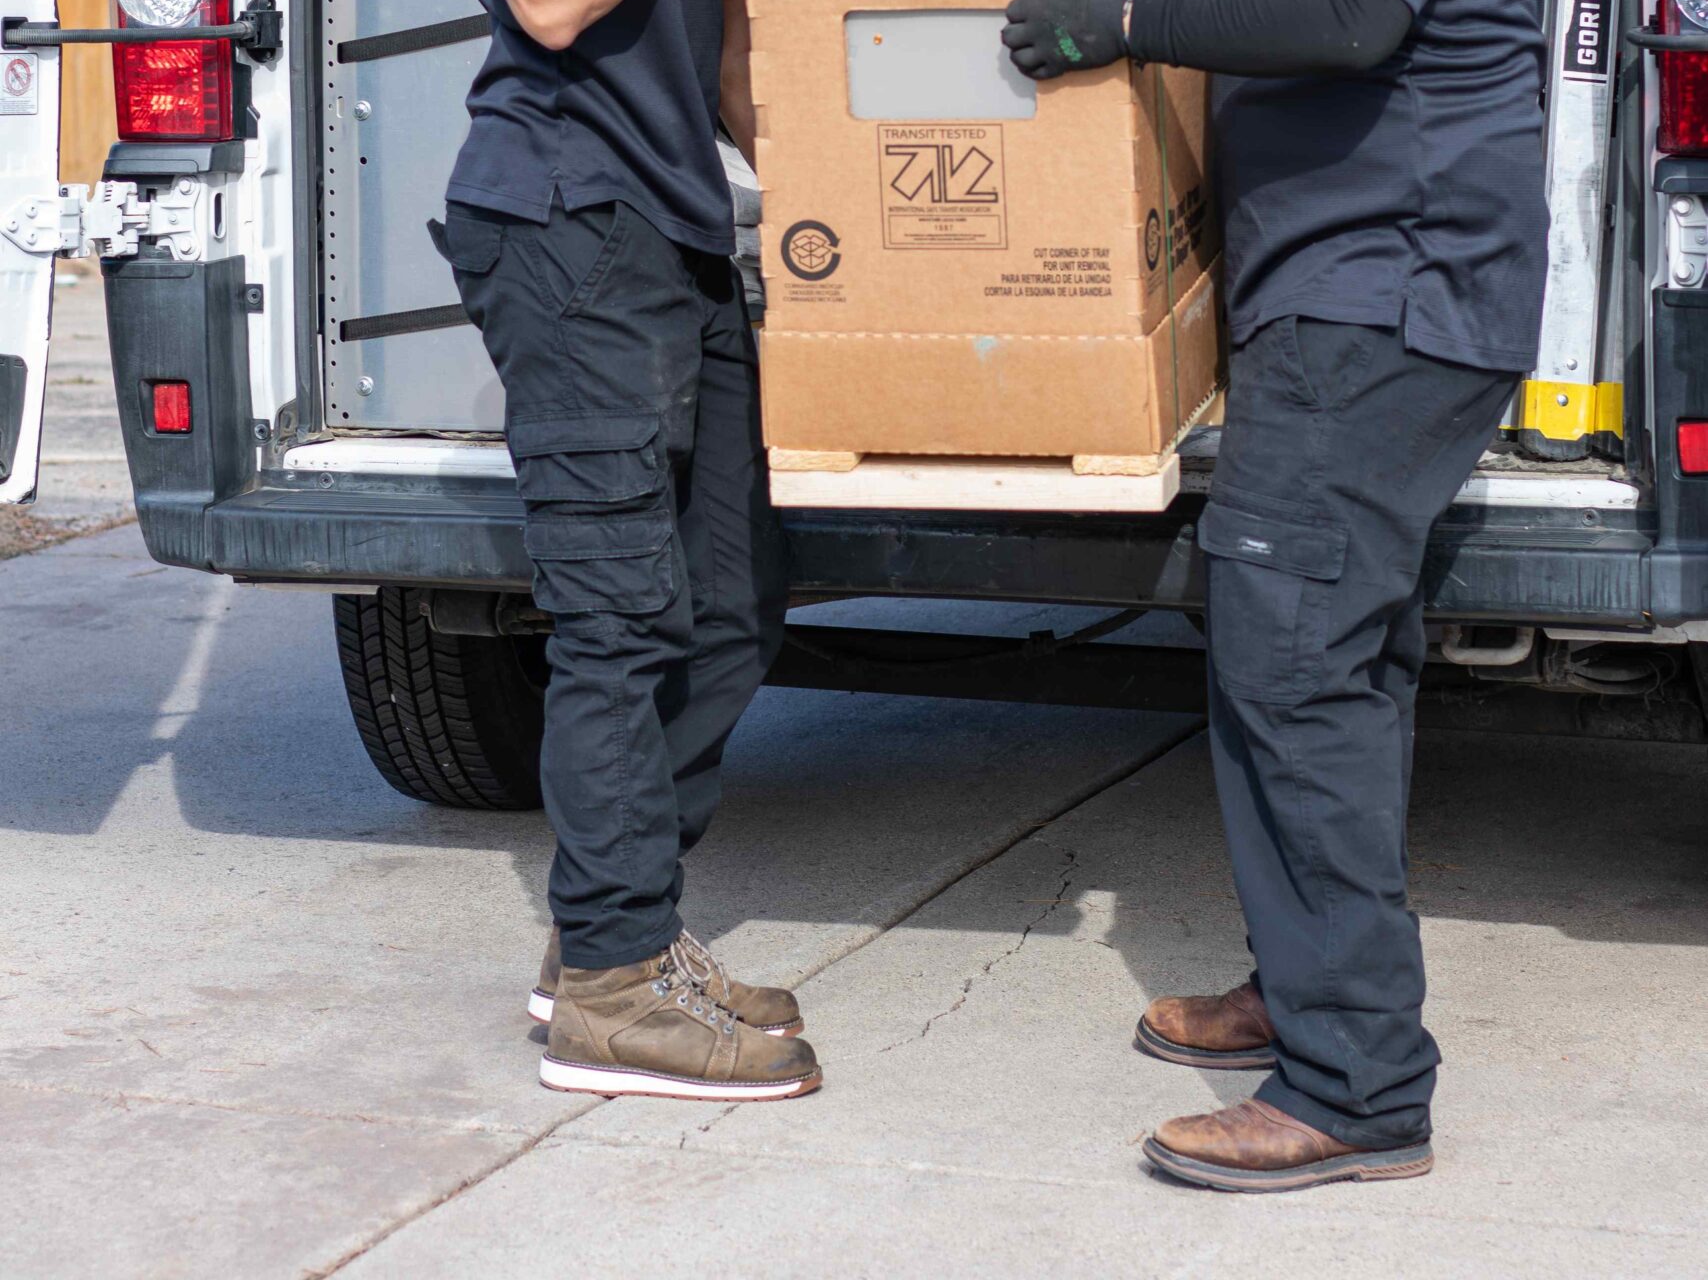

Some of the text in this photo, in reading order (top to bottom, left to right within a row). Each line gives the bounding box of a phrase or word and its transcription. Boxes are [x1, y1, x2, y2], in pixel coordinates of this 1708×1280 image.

[883, 128, 987, 139] TRANSIT TESTED
[1034, 248, 1110, 258] CUT CORNER OF TRAY
[1043, 261, 1111, 271] FOR UNIT REMOVAL
[1001, 274, 1112, 284] PARA RETIRARLO DE LA UNIDAD
[984, 287, 1112, 297] CORTAR LA ESQUINA DE LA BANDEJA
